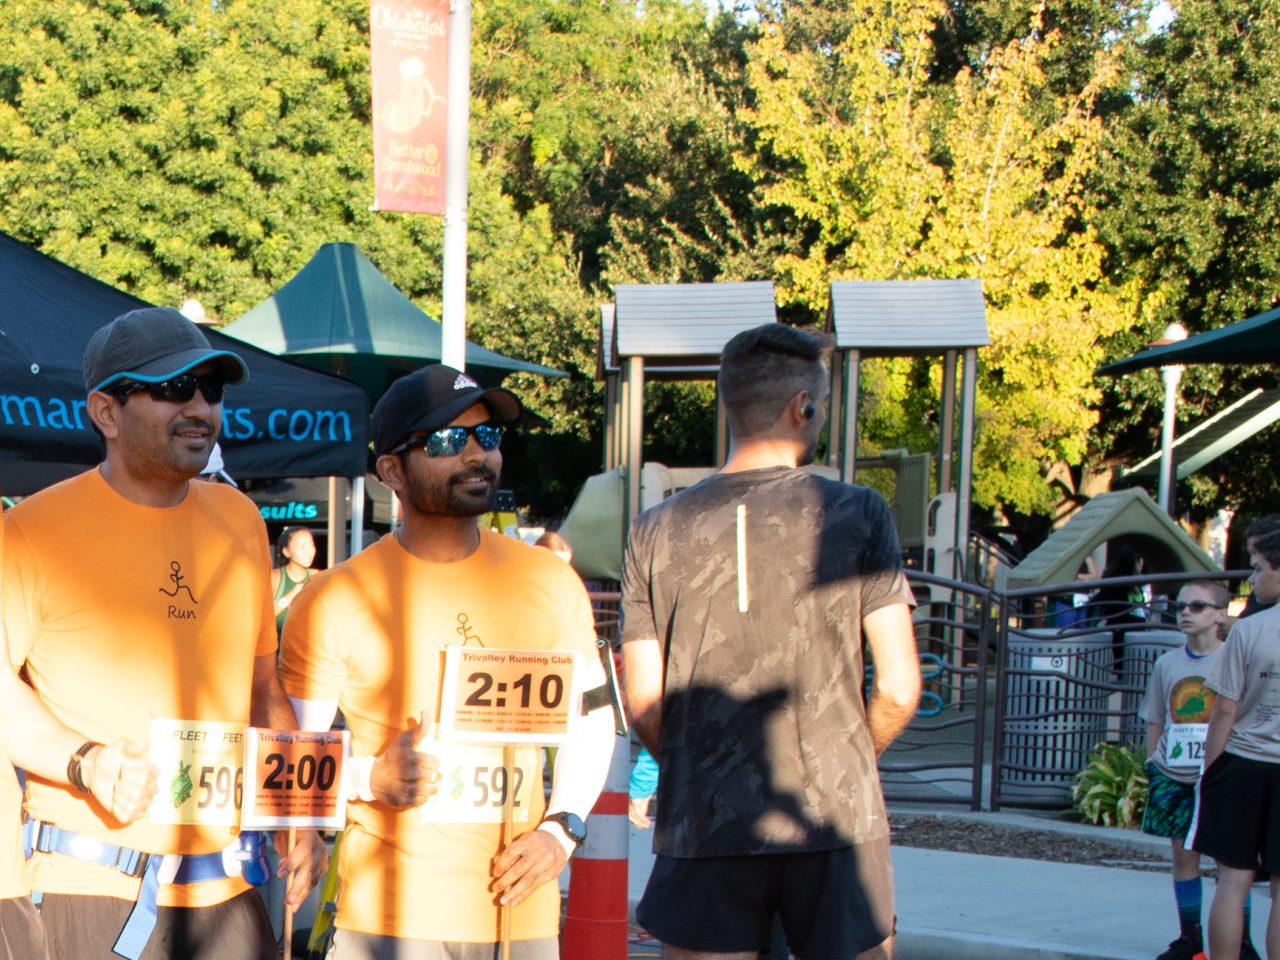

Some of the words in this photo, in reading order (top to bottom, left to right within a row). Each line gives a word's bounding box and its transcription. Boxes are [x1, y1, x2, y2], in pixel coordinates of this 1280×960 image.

[260, 501, 318, 519] sults
[168, 605, 196, 619] Run
[463, 653, 506, 664] Trivalley
[508, 655, 548, 665] Running
[551, 656, 573, 664] Club
[464, 671, 564, 709] 2:10
[172, 730, 208, 742] FLEET
[223, 732, 244, 743] FEET
[259, 733, 293, 744] Trivalley
[295, 735, 325, 746] Running
[262, 753, 337, 791] 2:00
[473, 766, 524, 808] 592
